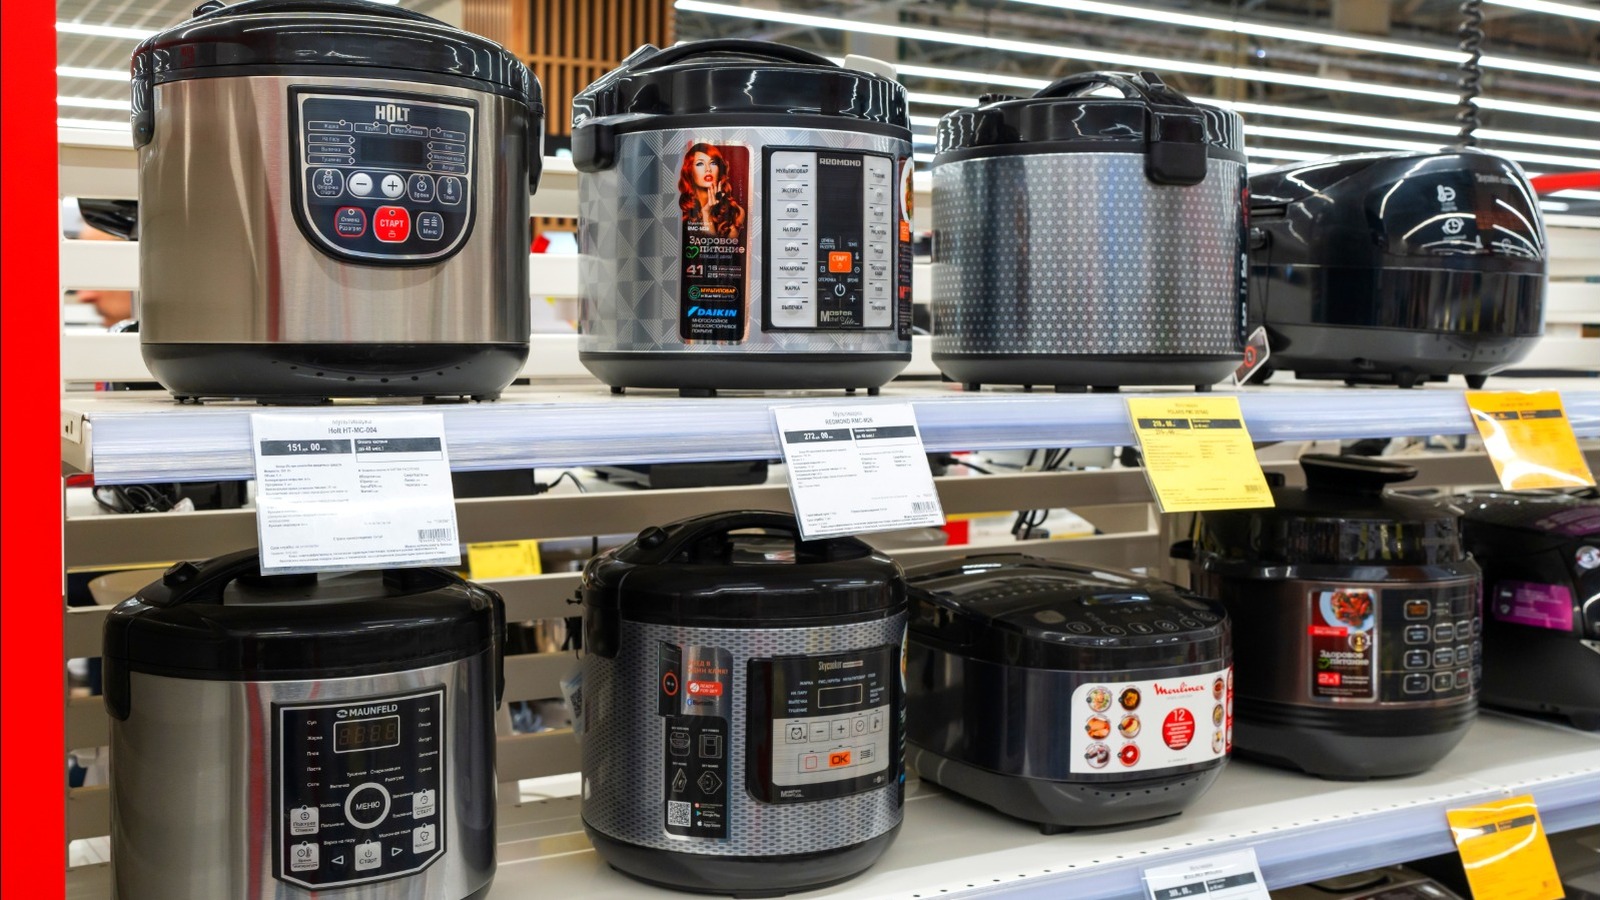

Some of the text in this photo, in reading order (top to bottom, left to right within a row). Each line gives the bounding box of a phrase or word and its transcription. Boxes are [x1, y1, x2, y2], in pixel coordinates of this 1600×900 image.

[375, 104, 410, 122] HOLT
[819, 157, 861, 167] REDMOND
[380, 219, 404, 228] СТАРТ
[690, 235, 738, 246] Здоровое
[700, 246, 745, 254] питание
[686, 264, 704, 275] 41
[697, 308, 738, 317] DAIKIN
[287, 443, 302, 451] 151
[310, 443, 320, 451] 00
[1320, 649, 1365, 659] Здоровое
[818, 660, 842, 672] Skycooker
[1153, 682, 1206, 696] Moulinex
[349, 704, 398, 717] MAUNFELD
[1173, 709, 1186, 722] 12
[831, 753, 849, 765] OK
[355, 801, 381, 811] МЕНЮ
[359, 857, 378, 865] Старт
